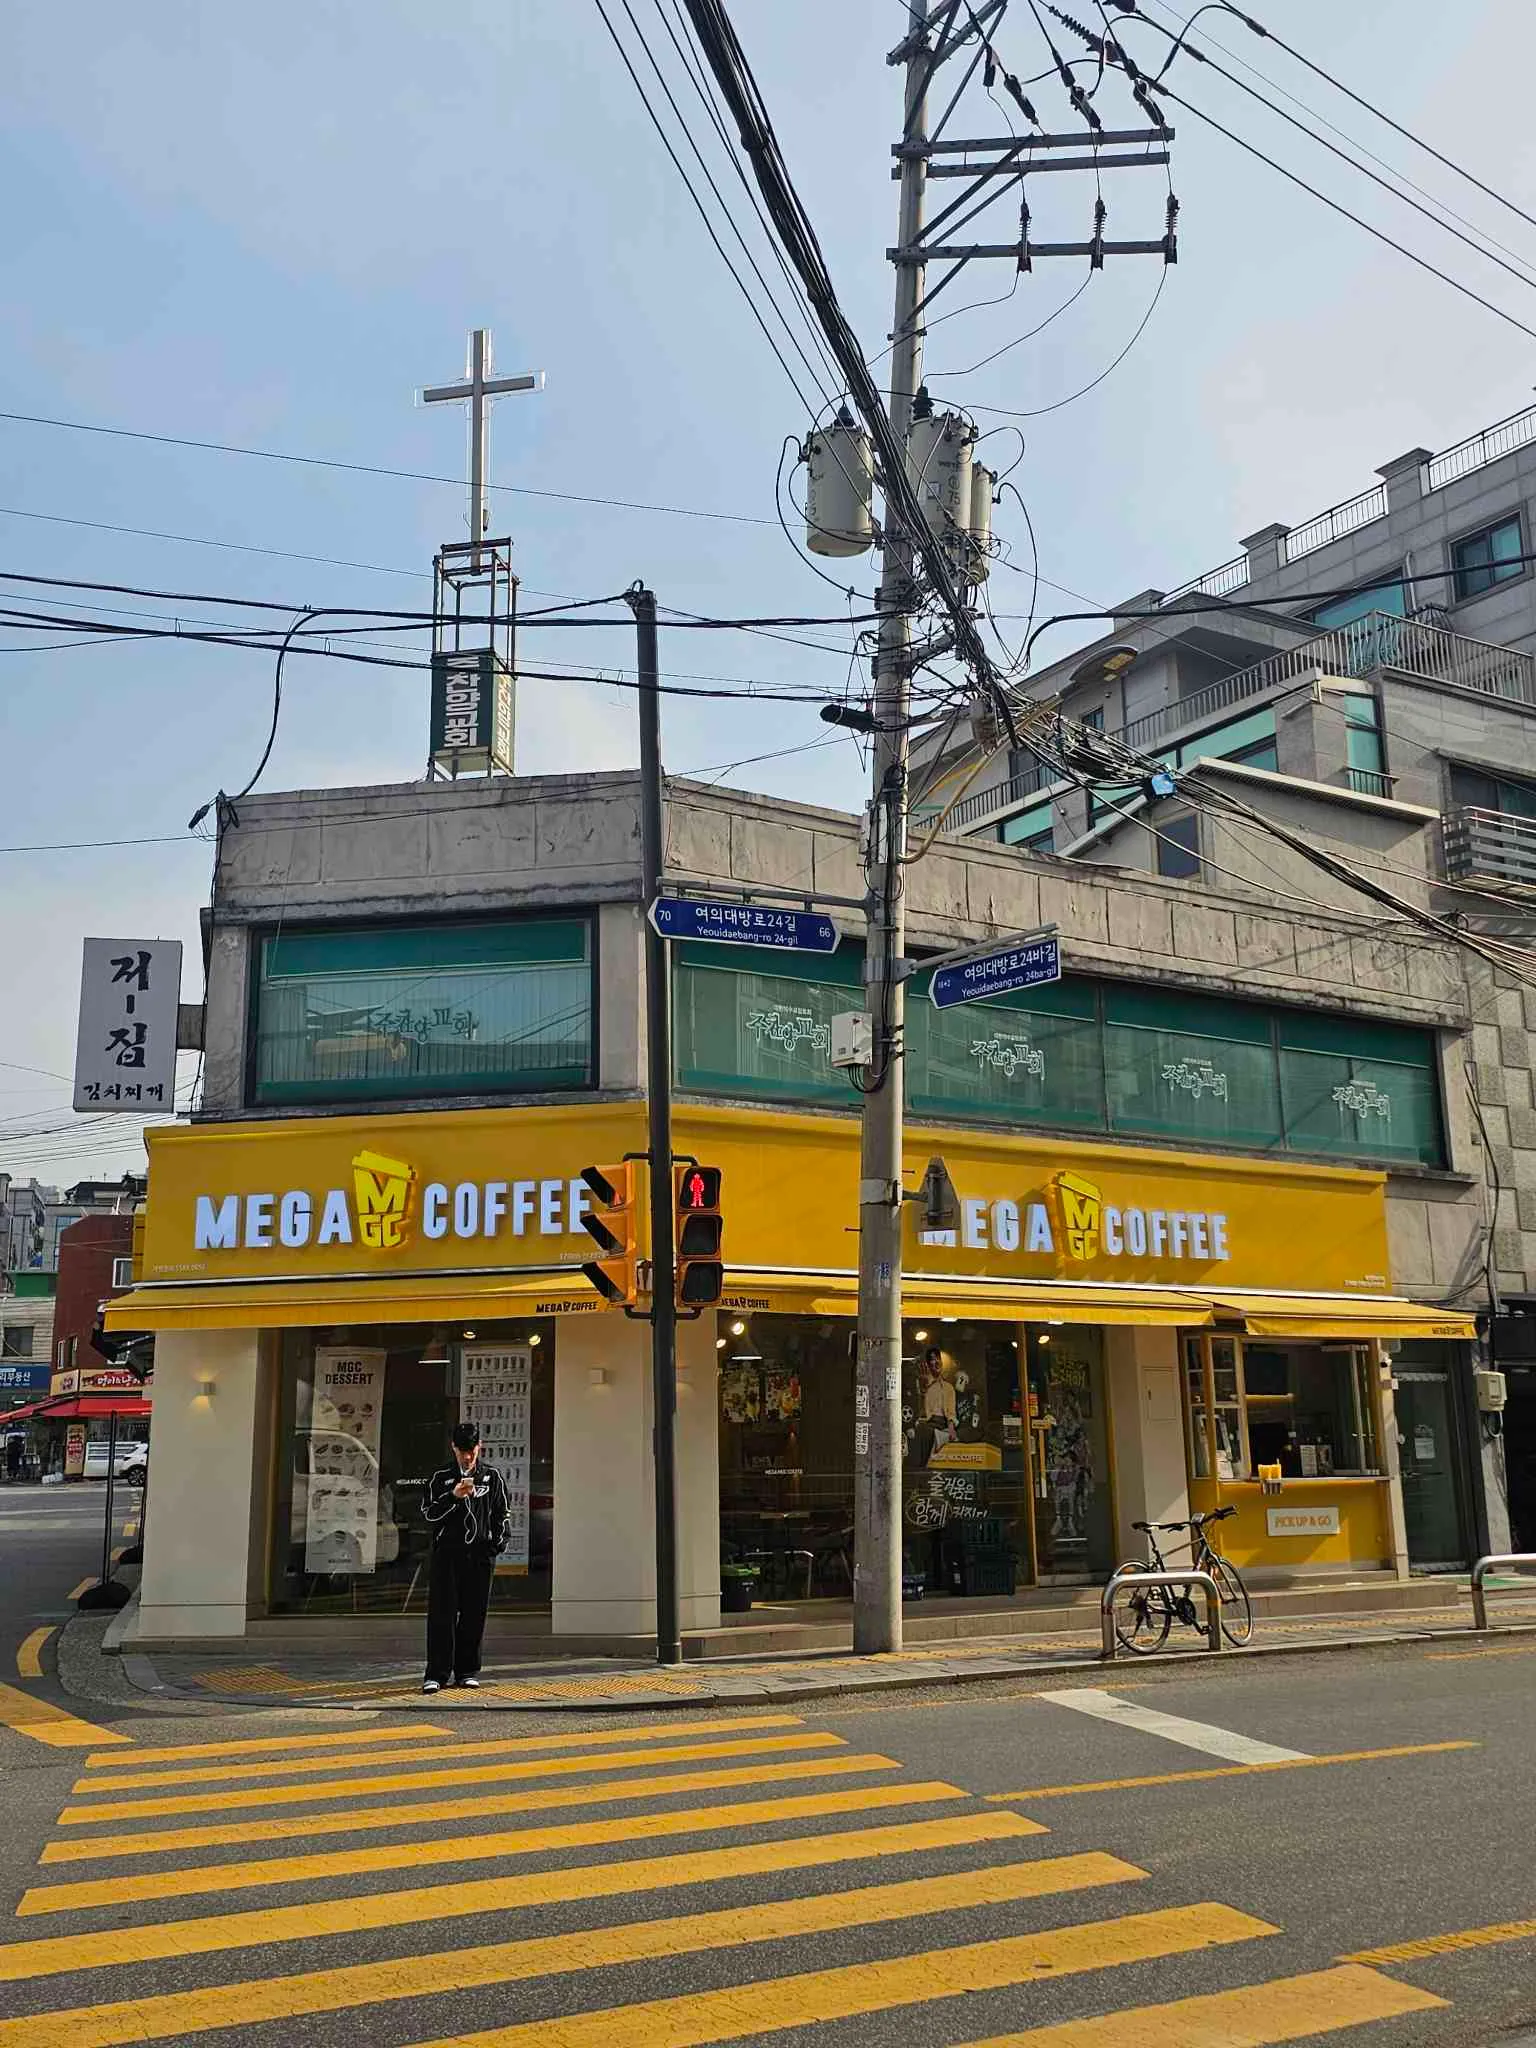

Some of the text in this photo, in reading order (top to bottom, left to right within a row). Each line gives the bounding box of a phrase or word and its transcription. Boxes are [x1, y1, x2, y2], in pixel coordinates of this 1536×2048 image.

[658, 910, 672, 921] 70
[695, 907, 797, 932] 여의대방로24길
[697, 926, 798, 945] Yeouidaebang-ro 24-gil
[819, 927, 831, 938] 66
[964, 942, 1056, 981] 여의대방로24바길
[961, 976, 1024, 998] Yeouidaebang-ro
[1026, 964, 1057, 982] 24ba-gil
[746, 1012, 831, 1057] 주찬양교회
[970, 1039, 1045, 1081] 주찬양교회
[83, 1082, 164, 1102] 김치찌개
[193, 1177, 594, 1250] MEGA COFFEE
[919, 1199, 1231, 1262] EGA COFFEE
[536, 1301, 598, 1313] MEGA COFFEE
[325, 1373, 374, 1385] DESSERT
[336, 1361, 363, 1373] MGC
[927, 1471, 977, 1501] 즐거움은
[915, 1497, 948, 1529] 함께
